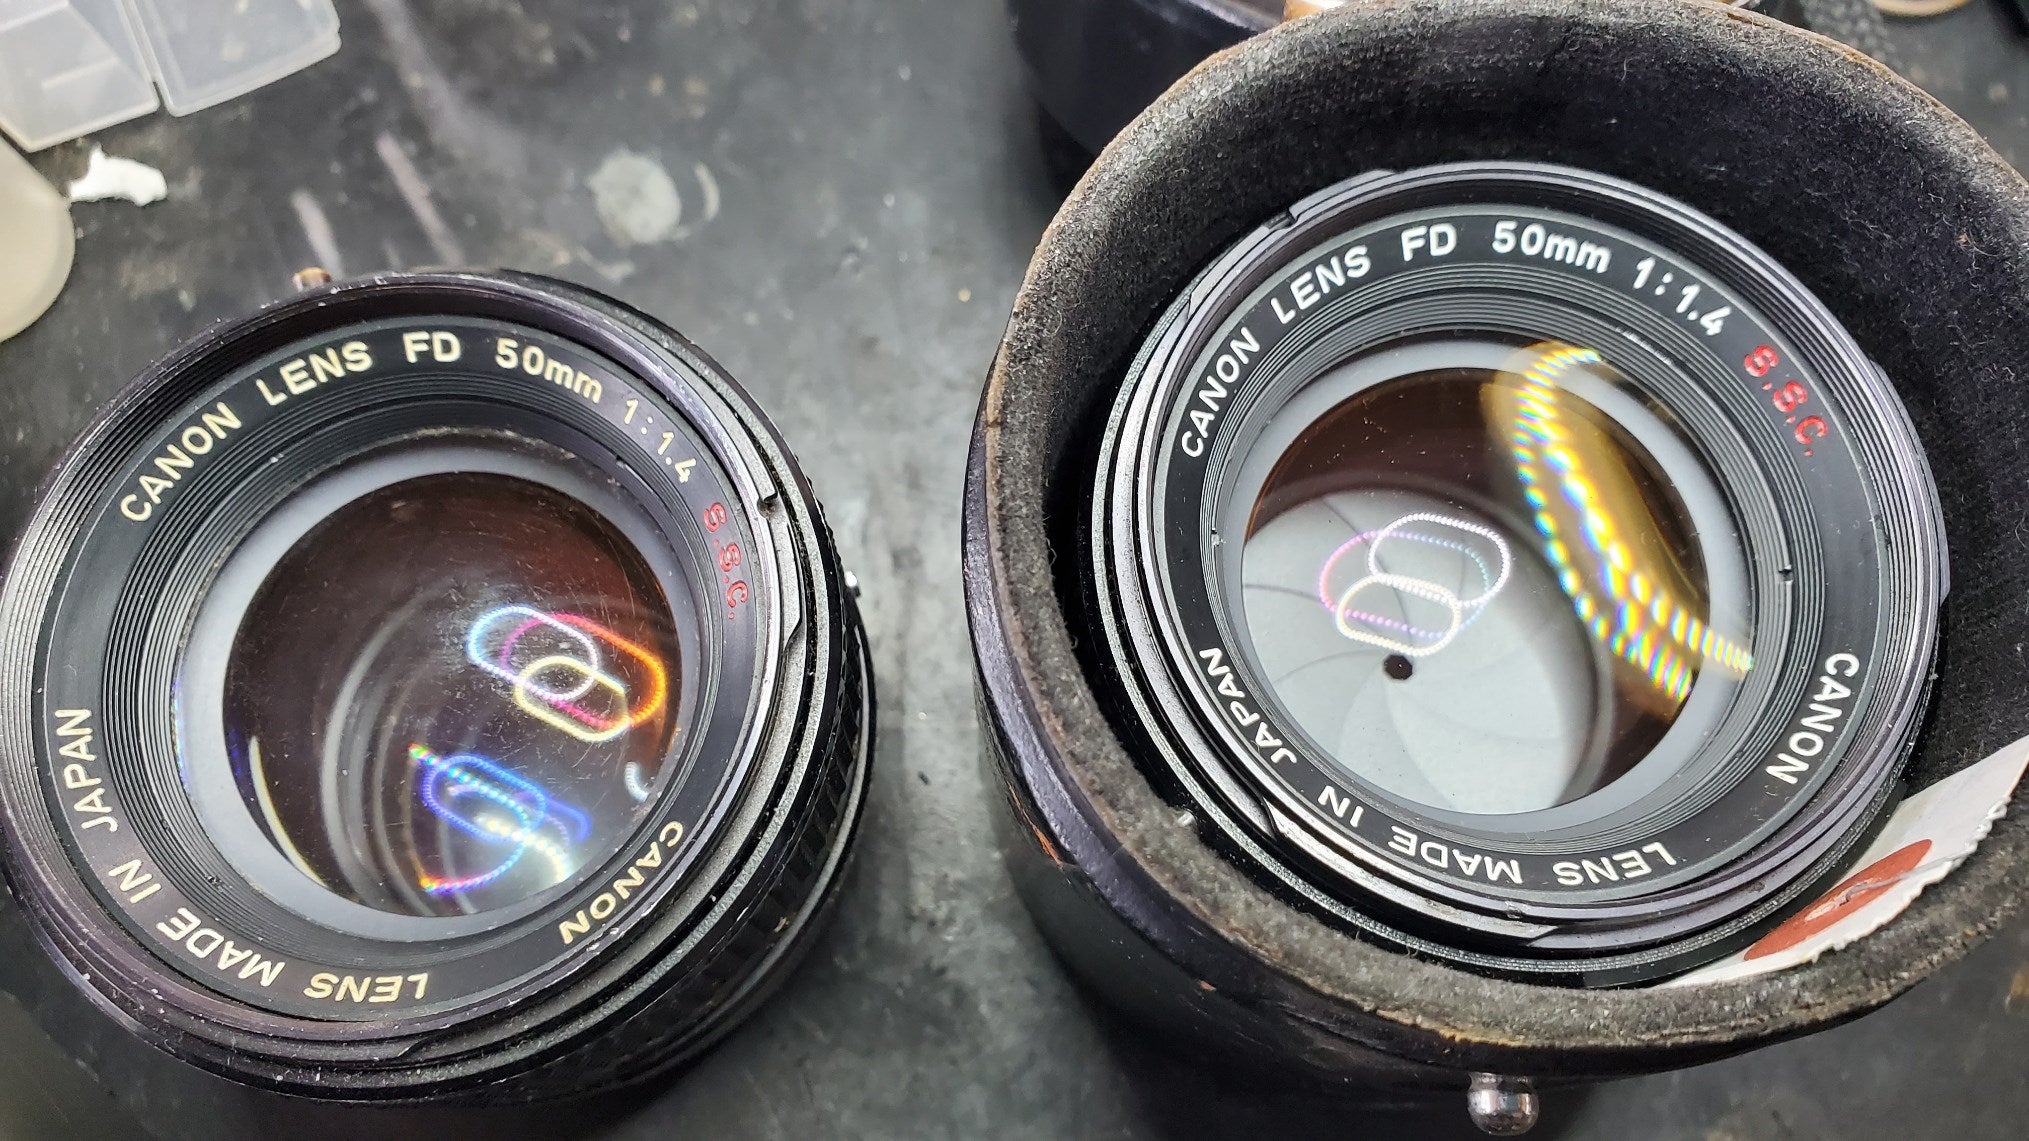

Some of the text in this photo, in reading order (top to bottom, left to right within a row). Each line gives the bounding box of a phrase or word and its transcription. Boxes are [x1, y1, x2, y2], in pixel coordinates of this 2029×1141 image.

[1180, 220, 1829, 458] CANON LENS FD 50mm 1:1.4 S.S.C.
[120, 331, 749, 620] CANON LENS FD 50mm 1:1.4 S.S.C.
[55, 709, 684, 1003] CANON LENS MADE IN JAPAN
[1199, 648, 1860, 886] CANON LENS MADE IN JAPAN
